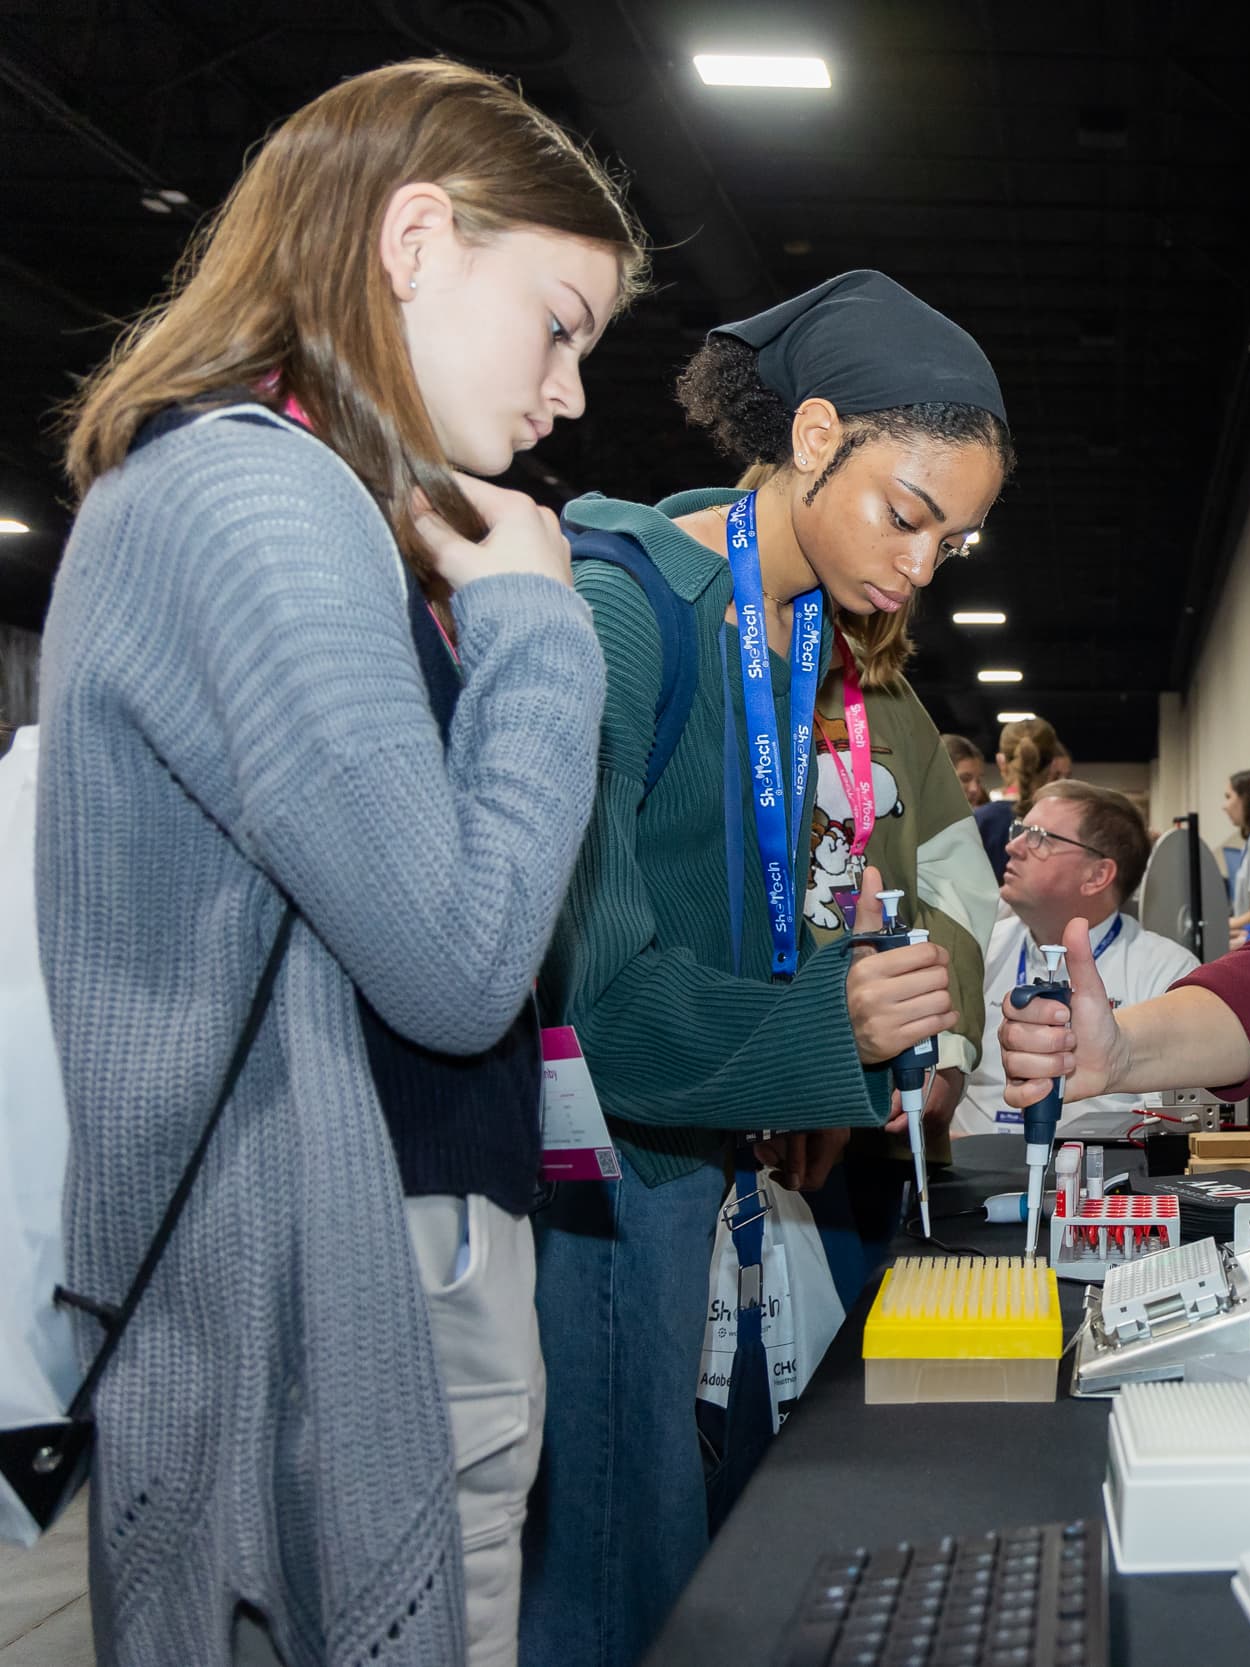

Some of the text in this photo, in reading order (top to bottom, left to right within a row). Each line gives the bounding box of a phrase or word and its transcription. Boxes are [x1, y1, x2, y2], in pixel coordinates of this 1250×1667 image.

[730, 495, 748, 549] SheTec
[742, 604, 763, 680] SheTech
[802, 602, 820, 673] SheTech
[755, 734, 775, 808] SheTech
[768, 861, 787, 933] SheTech
